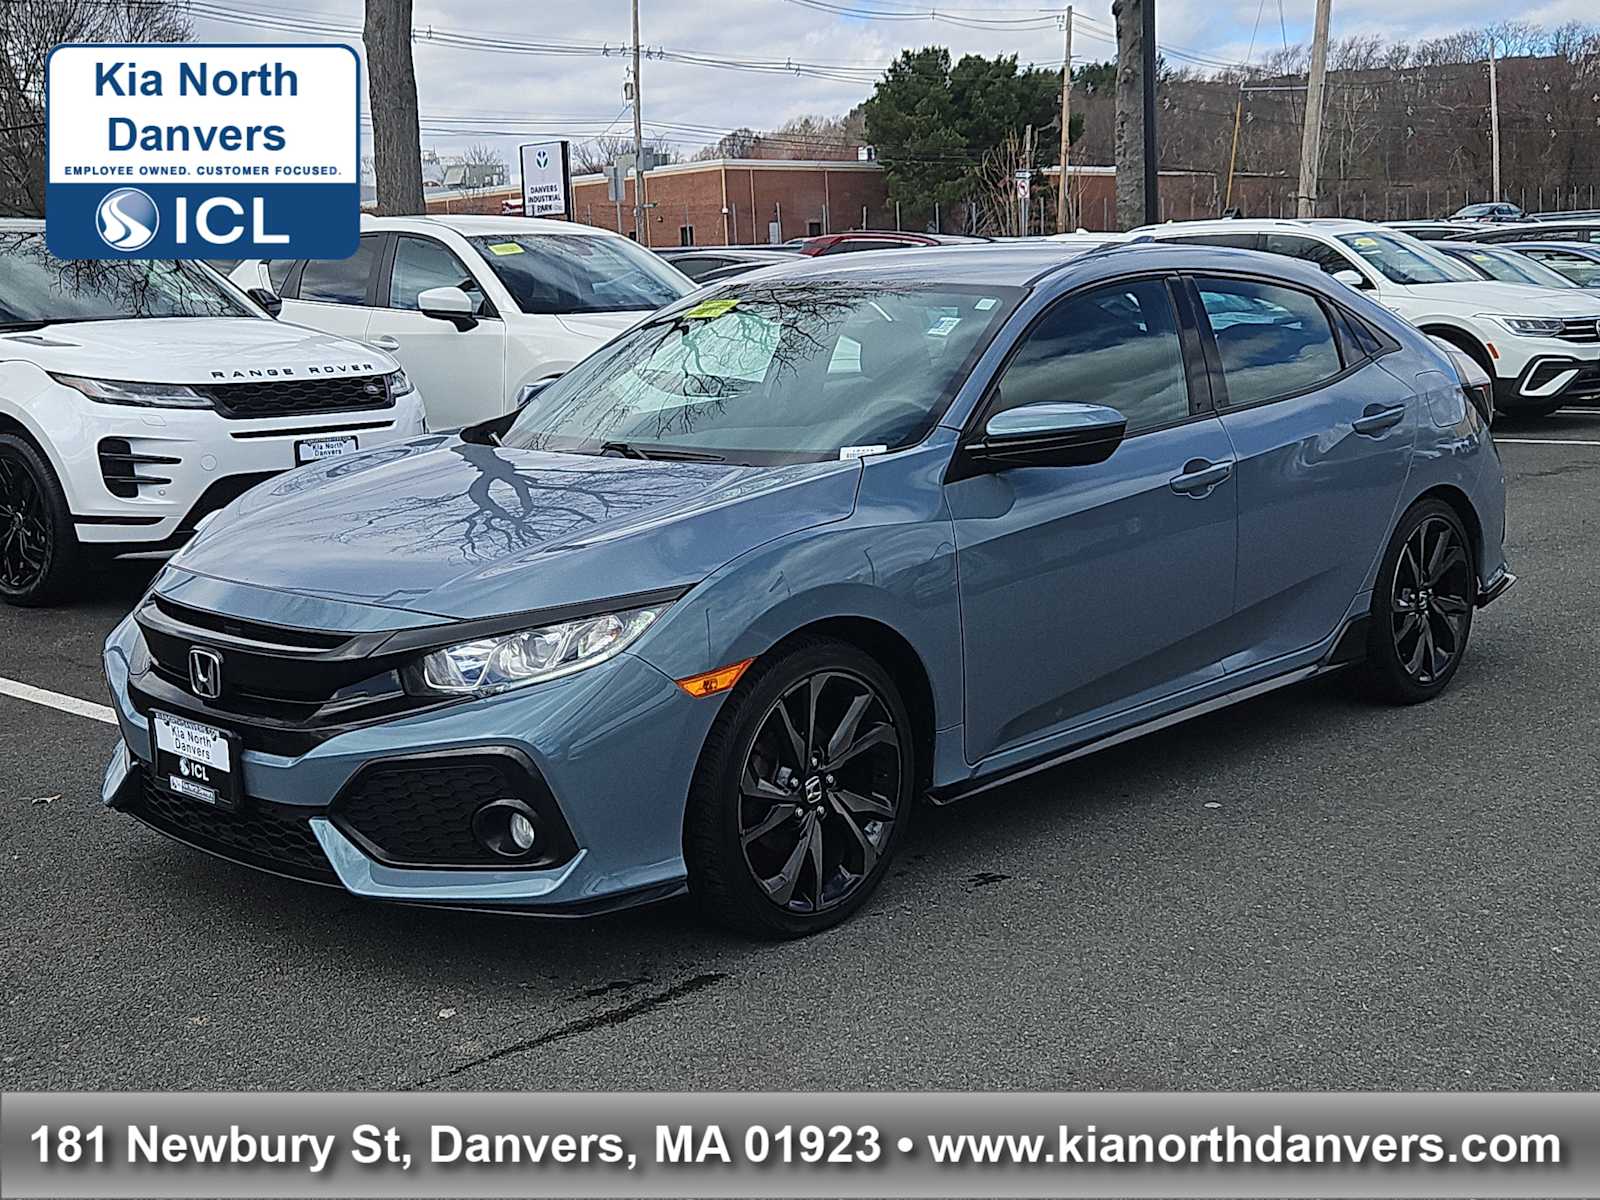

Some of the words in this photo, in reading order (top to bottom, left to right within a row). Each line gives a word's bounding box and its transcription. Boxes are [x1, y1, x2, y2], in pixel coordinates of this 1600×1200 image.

[531, 185, 558, 193] DANVERS
[527, 194, 561, 203] INDUSTRIAL
[537, 203, 553, 213] PARK
[211, 368, 294, 379] RANGE
[309, 363, 374, 375] ROVER
[312, 443, 324, 451] Kia
[314, 449, 342, 457] Danvers
[171, 725, 185, 740] Kia
[187, 731, 212, 748] North
[175, 738, 210, 760] Danvers
[190, 762, 210, 782] ICL
